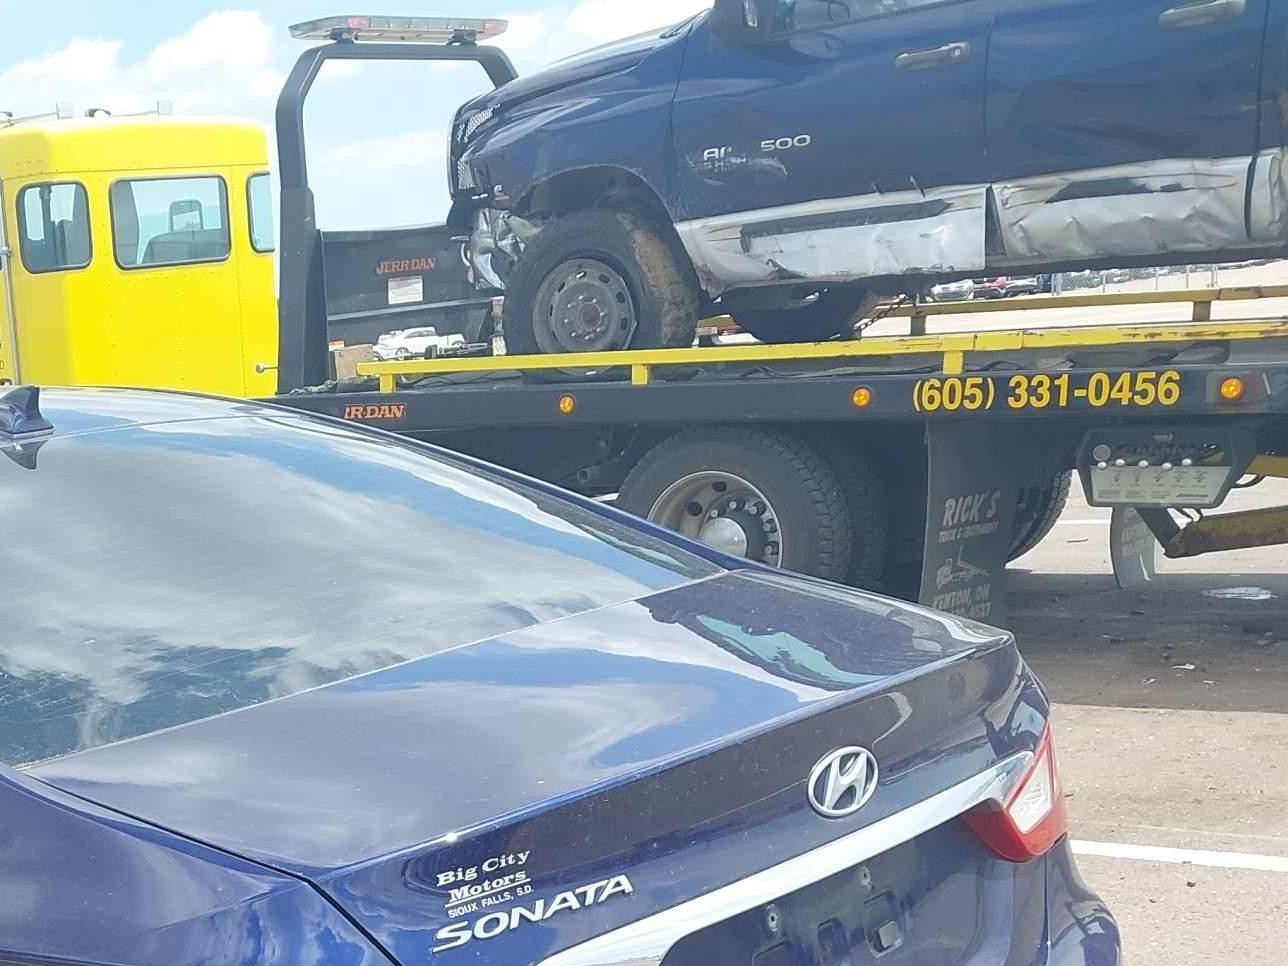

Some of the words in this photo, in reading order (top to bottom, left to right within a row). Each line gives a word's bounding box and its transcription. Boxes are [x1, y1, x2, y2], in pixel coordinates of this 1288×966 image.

[913, 377, 995, 411] (605)
[1007, 370, 1181, 408] 331-0456
[942, 490, 1001, 528] RICK'S
[436, 867, 479, 888] Big
[481, 850, 531, 873] City
[448, 870, 527, 903] Motors
[432, 874, 634, 953] SONATA
[448, 902, 479, 919] SIOUX
[481, 890, 514, 908] FALLS,
[516, 884, 535, 897] S.D.
